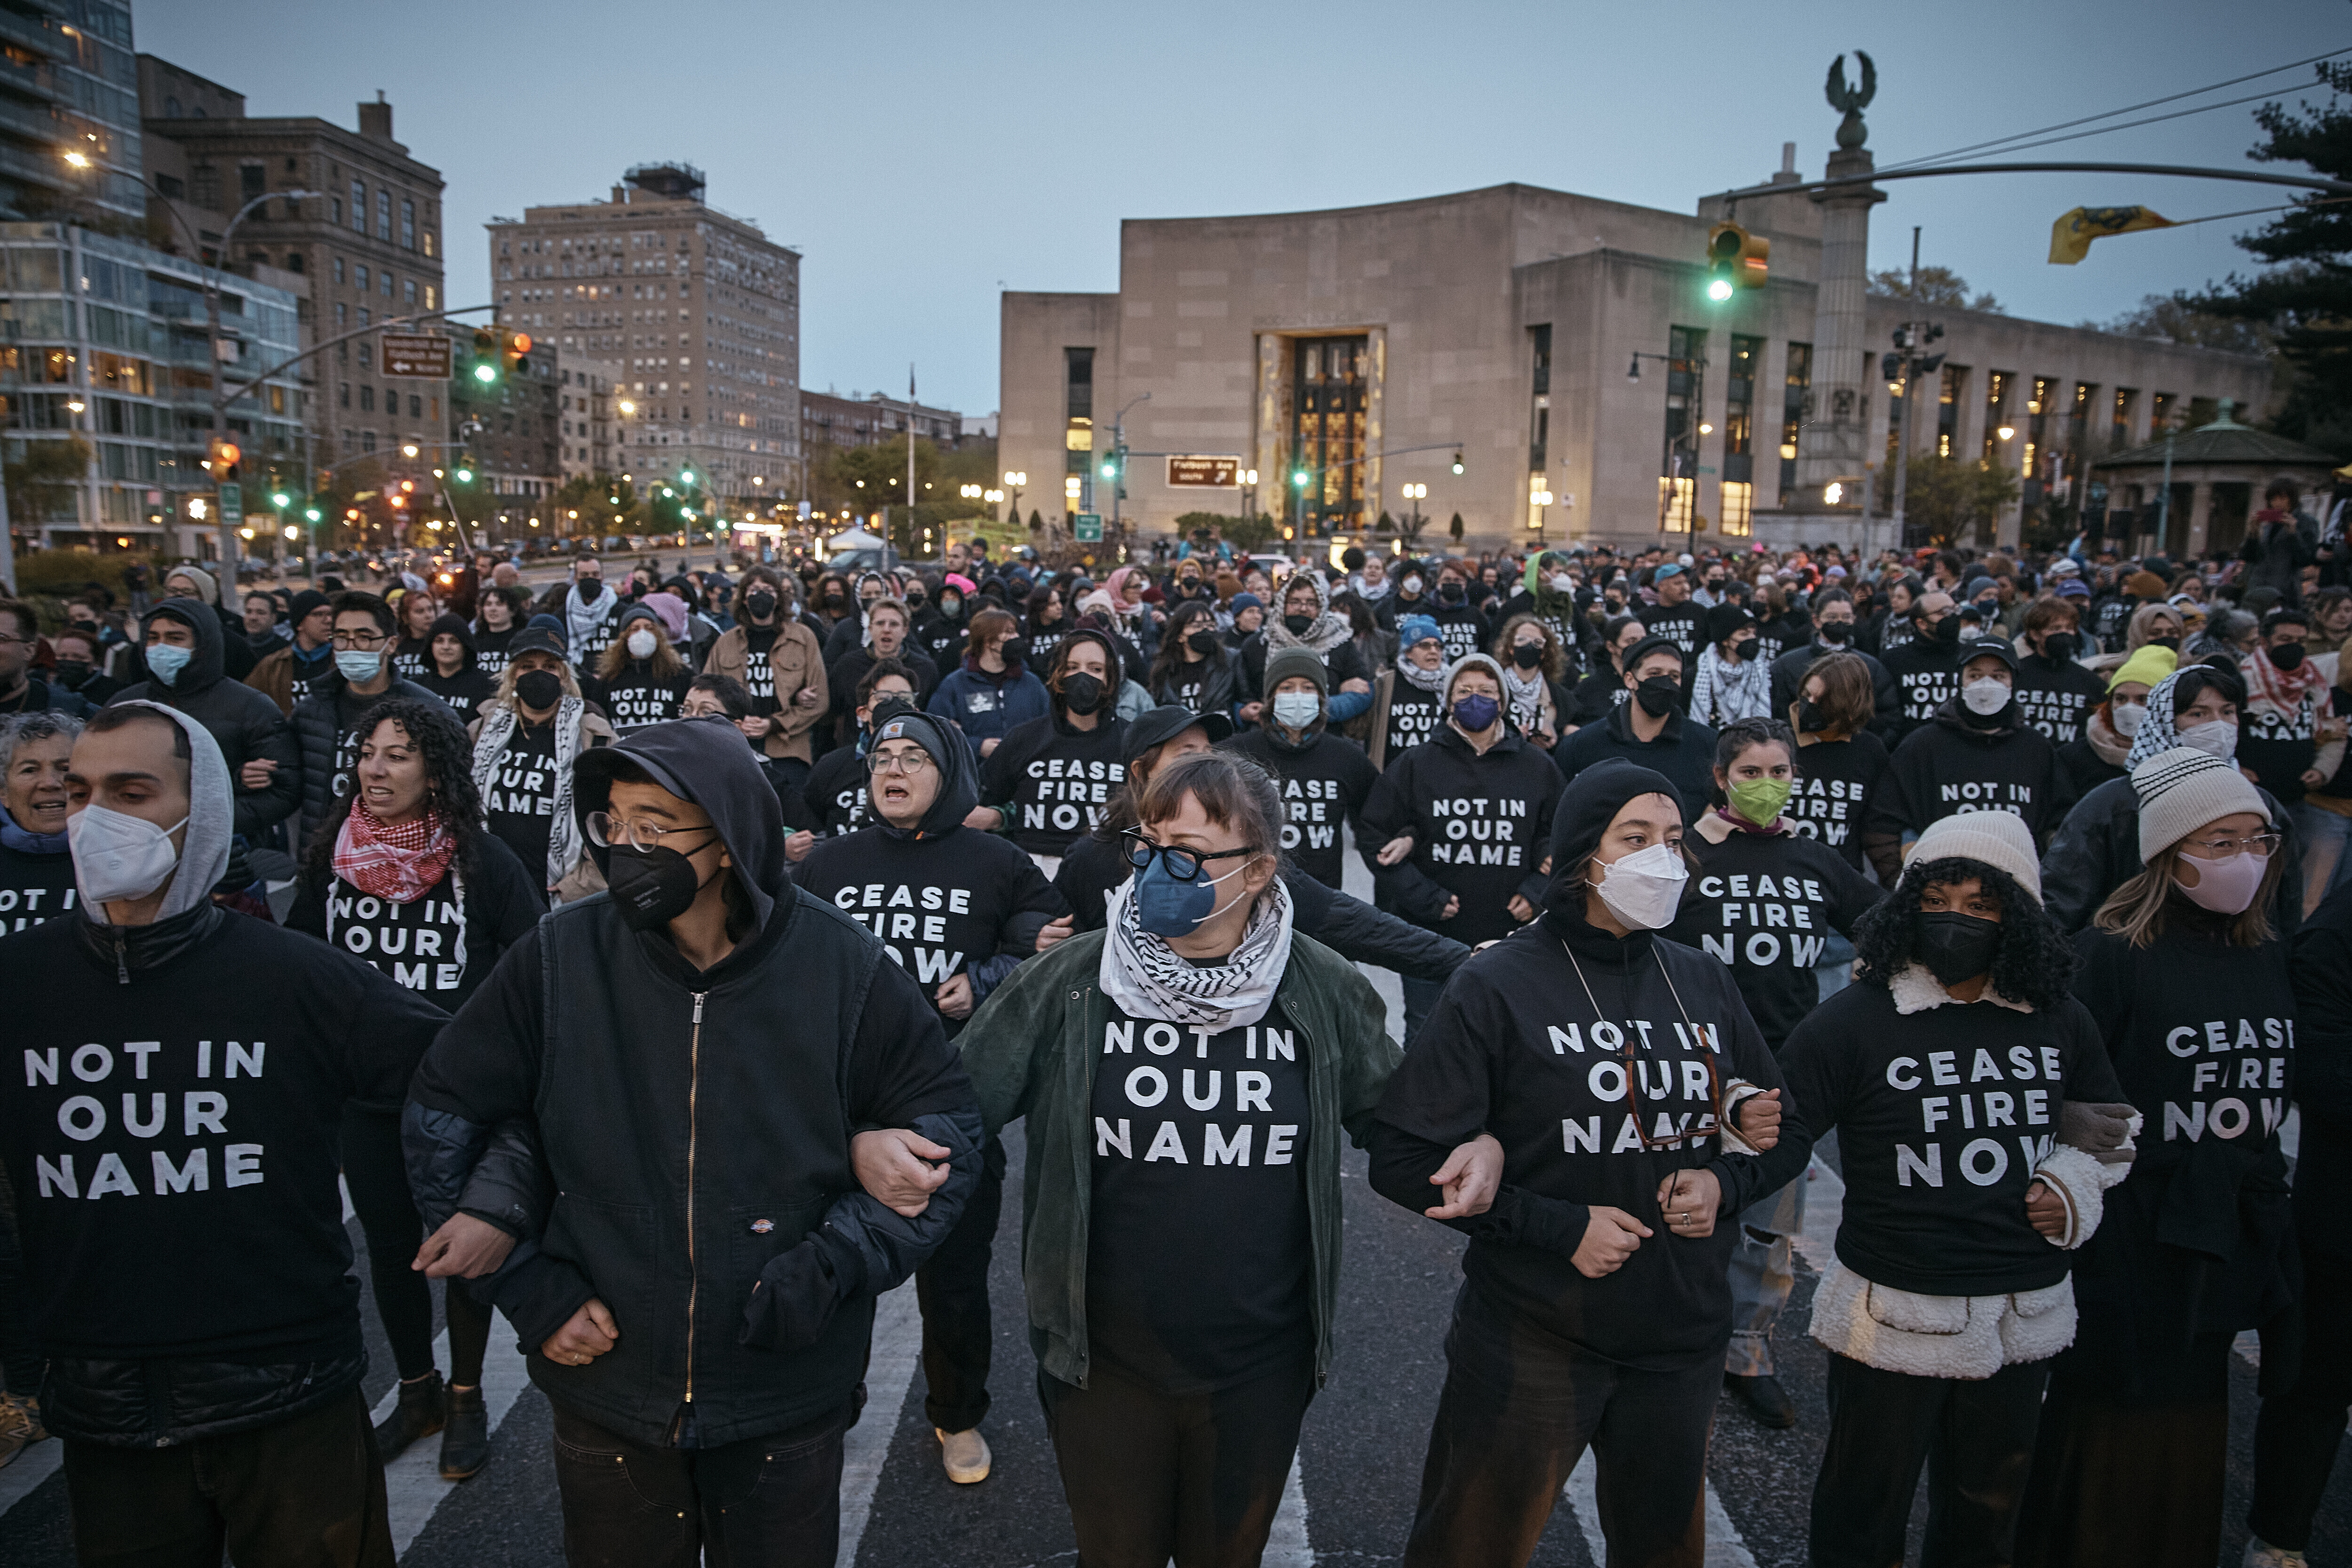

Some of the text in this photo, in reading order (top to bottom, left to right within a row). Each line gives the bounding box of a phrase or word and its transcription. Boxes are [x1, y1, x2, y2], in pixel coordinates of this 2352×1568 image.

[1438, 622, 1477, 634] EASE
[1650, 619, 1694, 633] CEASE
[1758, 636, 1783, 651] ASE
[399, 664, 430, 675] FIR
[747, 652, 766, 665] OT
[1902, 672, 1958, 687] NOT I
[449, 696, 469, 708] IN
[610, 687, 674, 702] NOT IN
[2015, 689, 2087, 708] CEASE
[616, 701, 664, 716] OUR
[1391, 703, 1430, 716] NOT
[2024, 704, 2074, 723] FIRE
[1391, 732, 1430, 747] NA
[2024, 720, 2078, 742] OW
[2249, 725, 2311, 741] NAM
[500, 748, 528, 767] OT
[493, 768, 544, 792] UR
[1027, 759, 1125, 782] CEASE
[1037, 781, 1108, 803] FIRE
[1271, 779, 1338, 799] ASE
[1790, 777, 1864, 801] EASE
[1941, 782, 2031, 804] NOT IN
[490, 790, 554, 815] AME
[1432, 798, 1526, 817] NOT IN
[1779, 798, 1848, 820] FIRE
[1279, 824, 1335, 849] OW
[1446, 819, 1514, 841] OUR
[1795, 819, 1851, 846] OW
[1432, 843, 1522, 867] NAME
[834, 884, 971, 915] CEASE
[1699, 874, 1824, 902] CEASE
[0, 888, 76, 912] OT I
[1723, 903, 1813, 929] FIRE
[344, 925, 442, 956] OUR
[1701, 932, 1825, 968] NOW
[366, 961, 460, 990] ME
[1103, 1021, 1295, 1062] NOT IN
[1547, 1020, 1721, 1055] NOT IN
[24, 1041, 266, 1087] NOT IN
[1886, 1045, 2061, 1090] CEASE
[1124, 1065, 1273, 1112] OUR
[1588, 1060, 1709, 1102] OUR
[57, 1090, 229, 1141] OUR
[1922, 1089, 2050, 1133] FIRE
[1095, 1117, 1298, 1167] NAME
[36, 1143, 264, 1200] NAME
